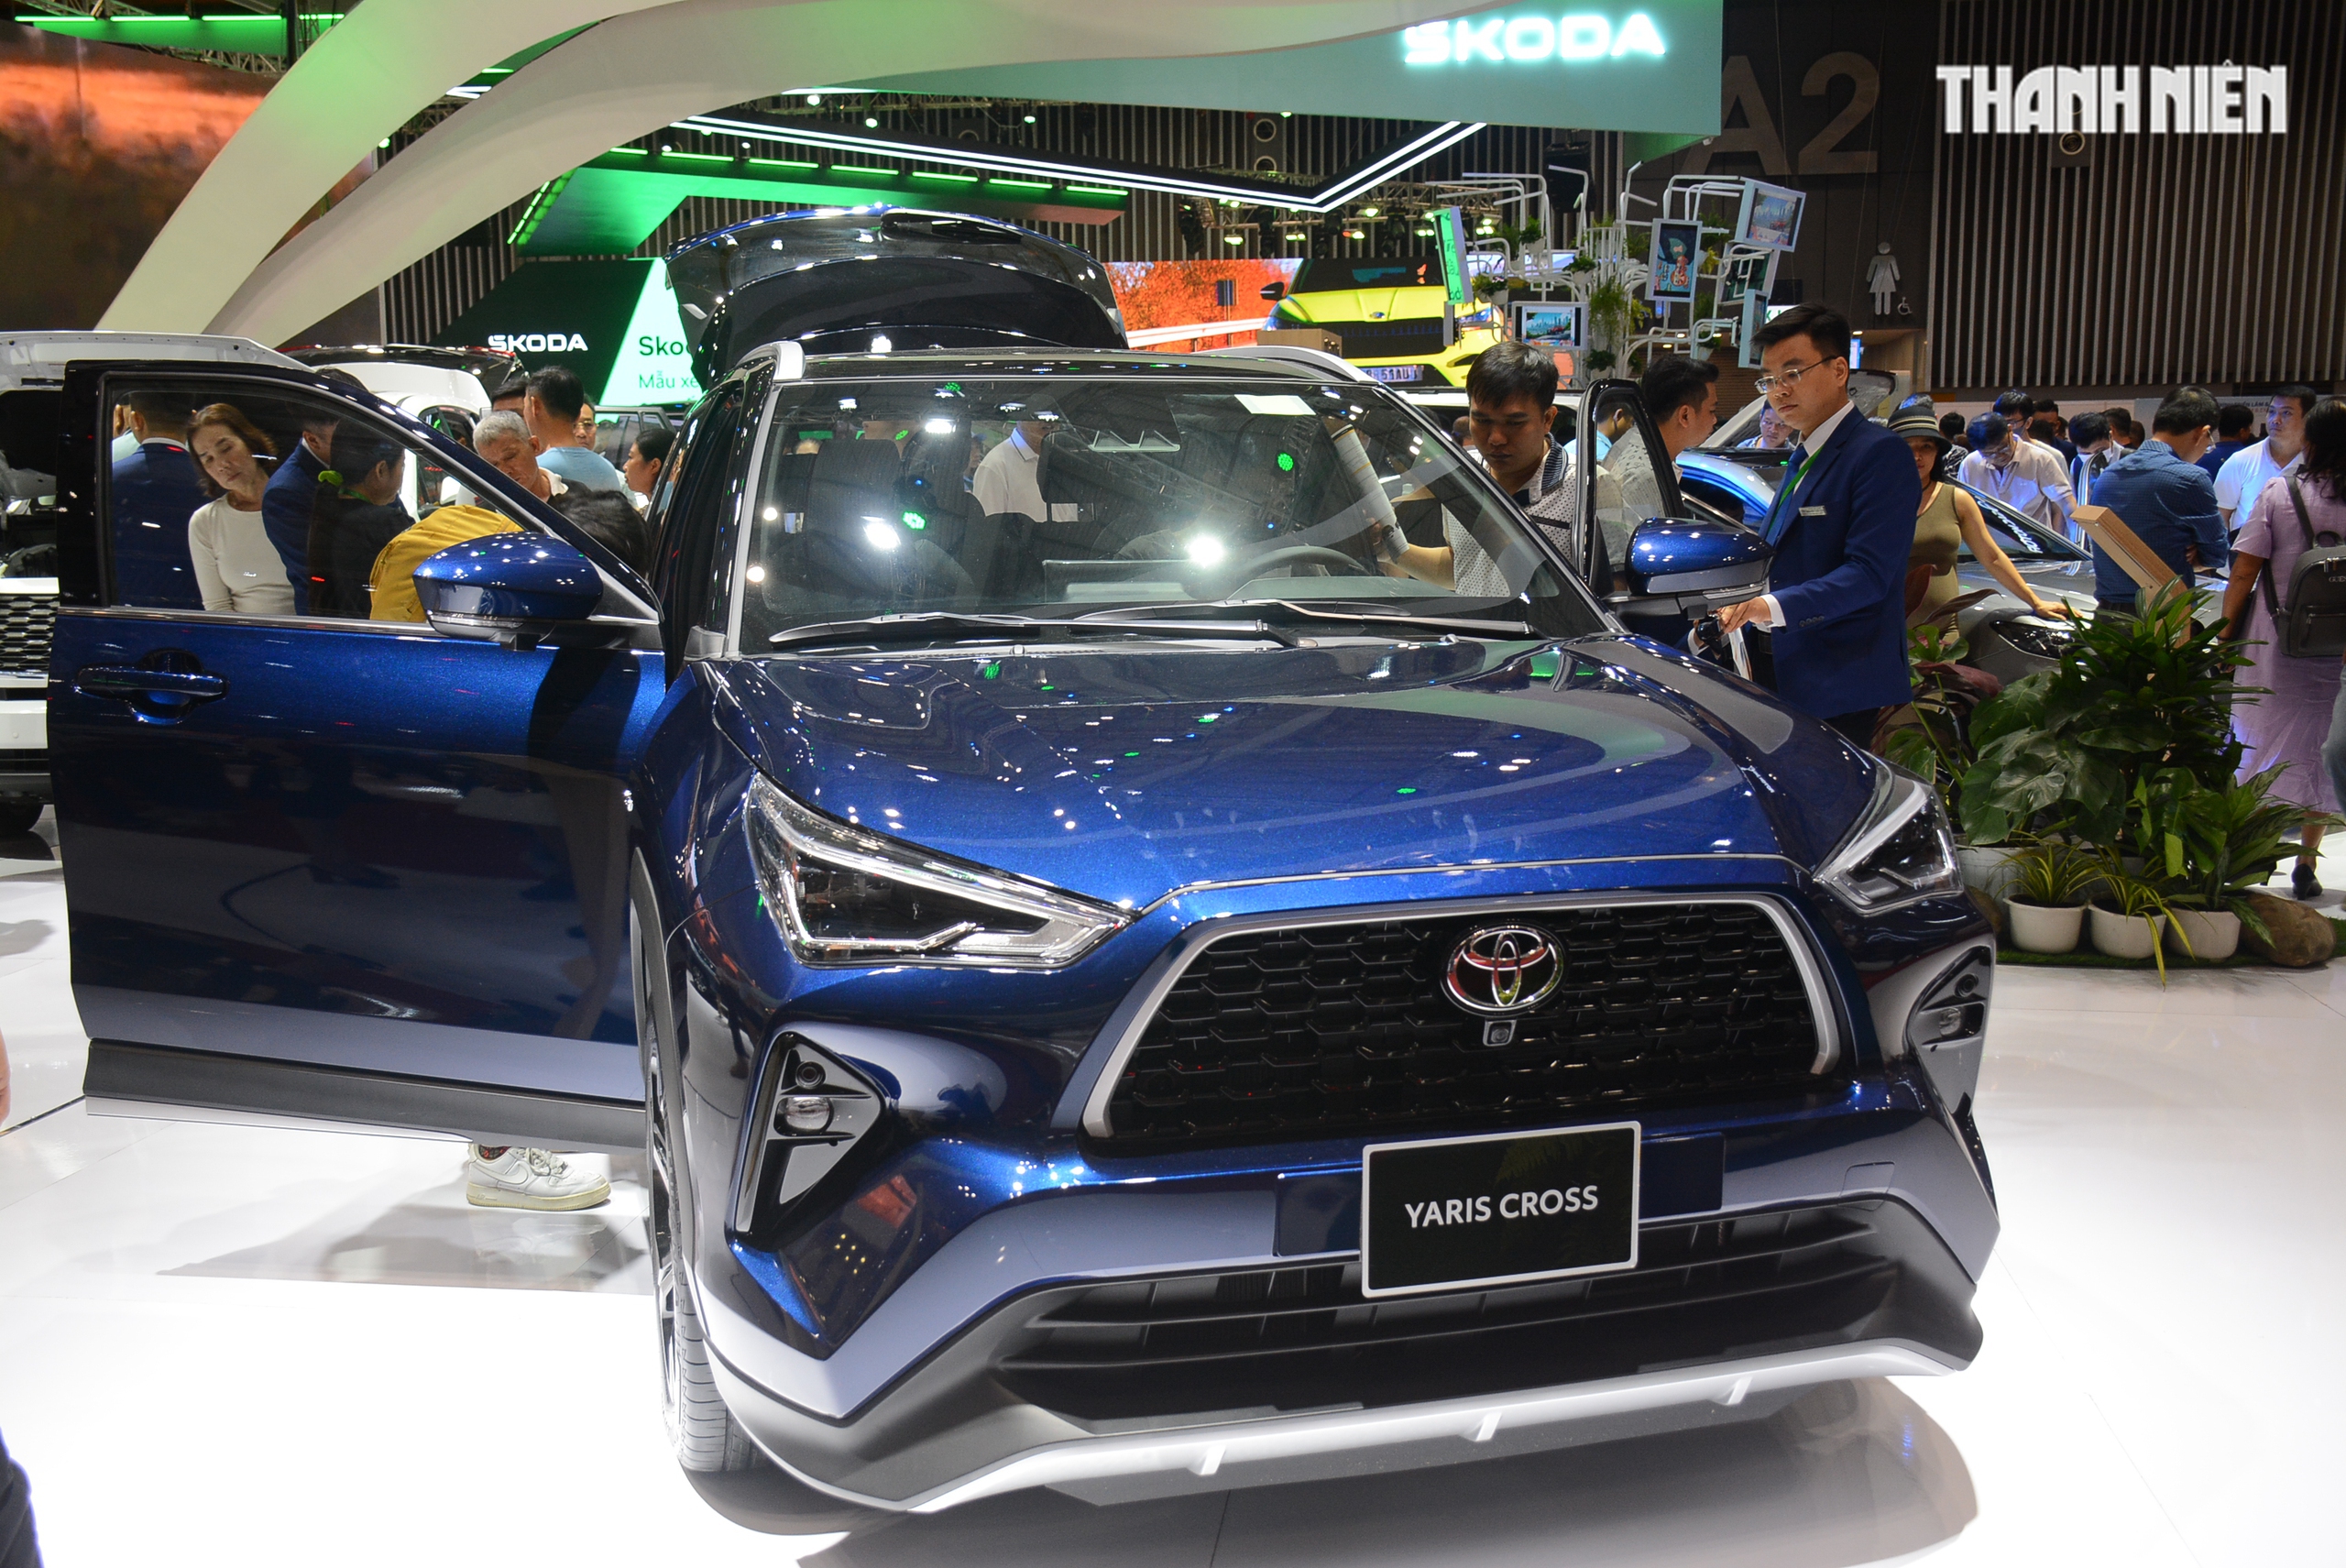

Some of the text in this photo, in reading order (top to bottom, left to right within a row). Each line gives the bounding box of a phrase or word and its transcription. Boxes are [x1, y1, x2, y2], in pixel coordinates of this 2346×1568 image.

[1680, 51, 1880, 176] A2
[1405, 1185, 1598, 1228] YARIS CROSS
